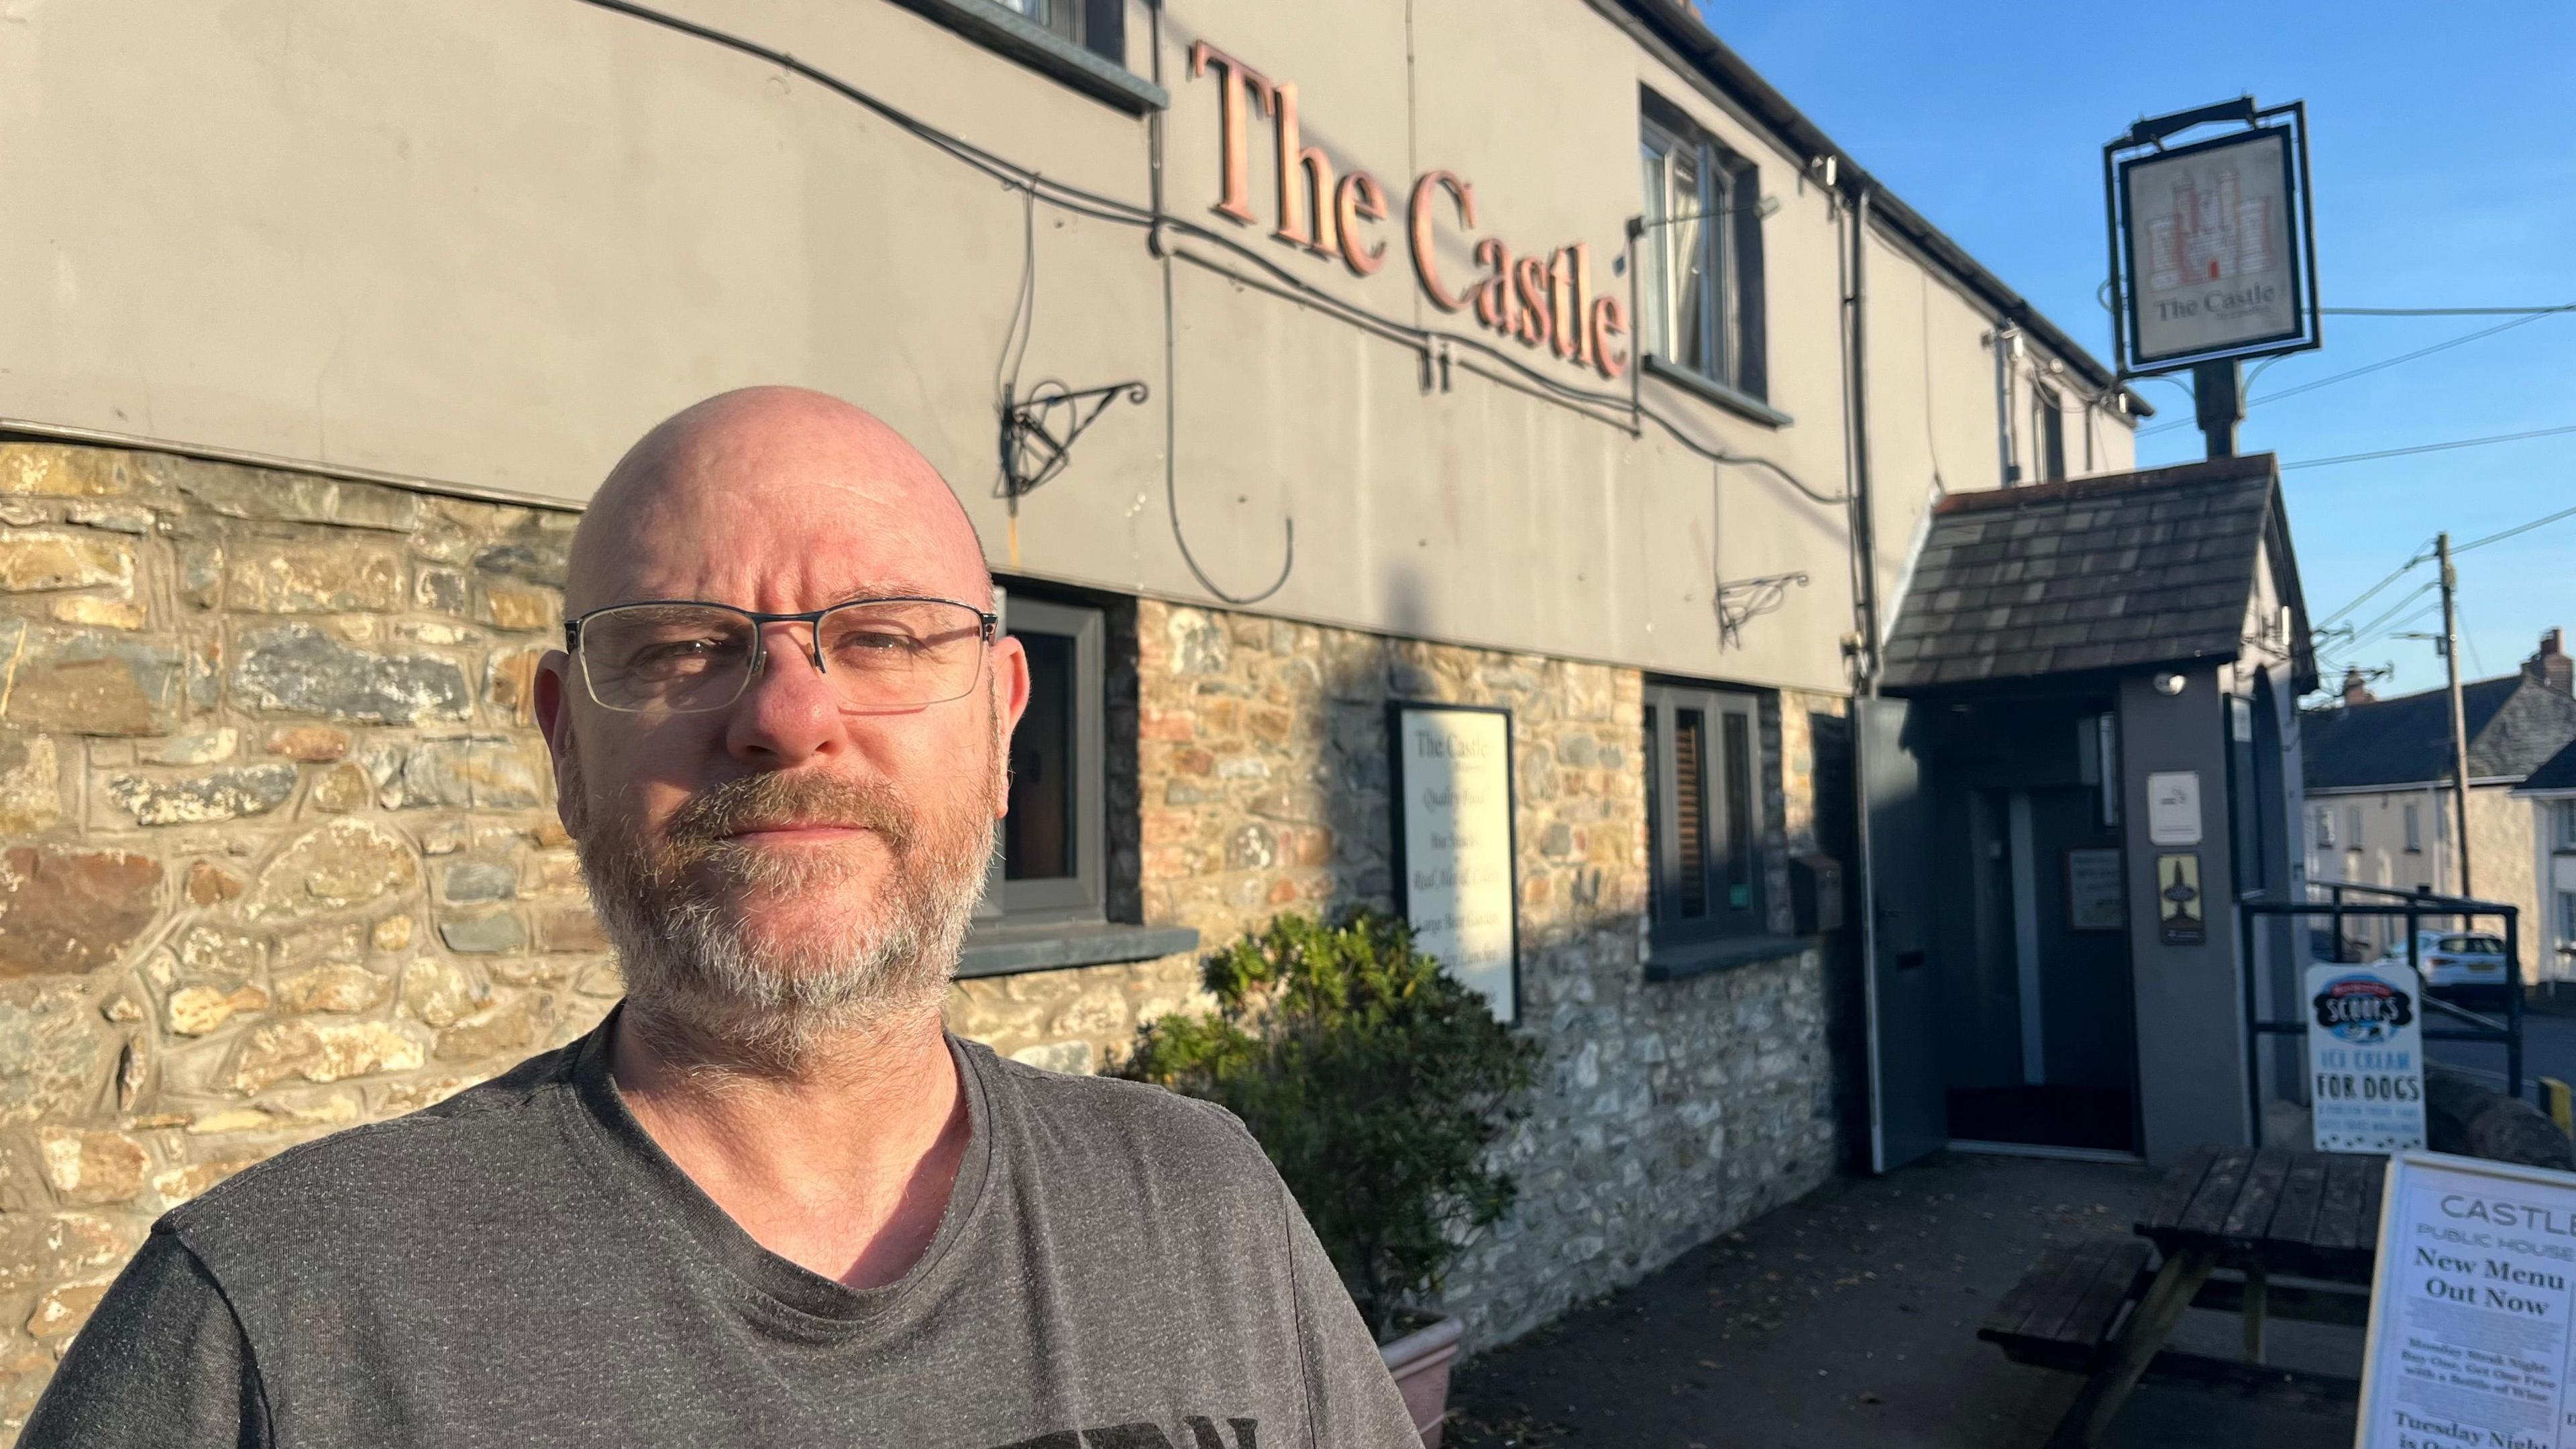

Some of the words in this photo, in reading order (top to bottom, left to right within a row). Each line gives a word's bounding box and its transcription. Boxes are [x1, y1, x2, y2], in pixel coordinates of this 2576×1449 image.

[1189, 39, 1388, 276] The
[1409, 170, 1627, 378] Castle
[2154, 297, 2198, 321] The
[2204, 282, 2275, 313] Castle
[1415, 730, 1444, 759] The
[1447, 733, 1489, 759] Castle
[2320, 1051, 2346, 1068] ICE
[2354, 1051, 2410, 1071] CREAM
[2318, 1075, 2357, 1099] FOR
[2364, 1076, 2419, 1102] DOGS
[2418, 1223, 2491, 1248] PUBLIC
[2498, 1238, 2575, 1262] HOUSE
[2415, 1246, 2477, 1273] New
[2483, 1258, 2565, 1291] Menu
[2426, 1276, 2477, 1304] Out
[2485, 1286, 2549, 1316] Now
[2401, 1348, 2426, 1364] Buy
[2524, 1375, 2556, 1389] Free
[2394, 1410, 2479, 1446] Tuesday
